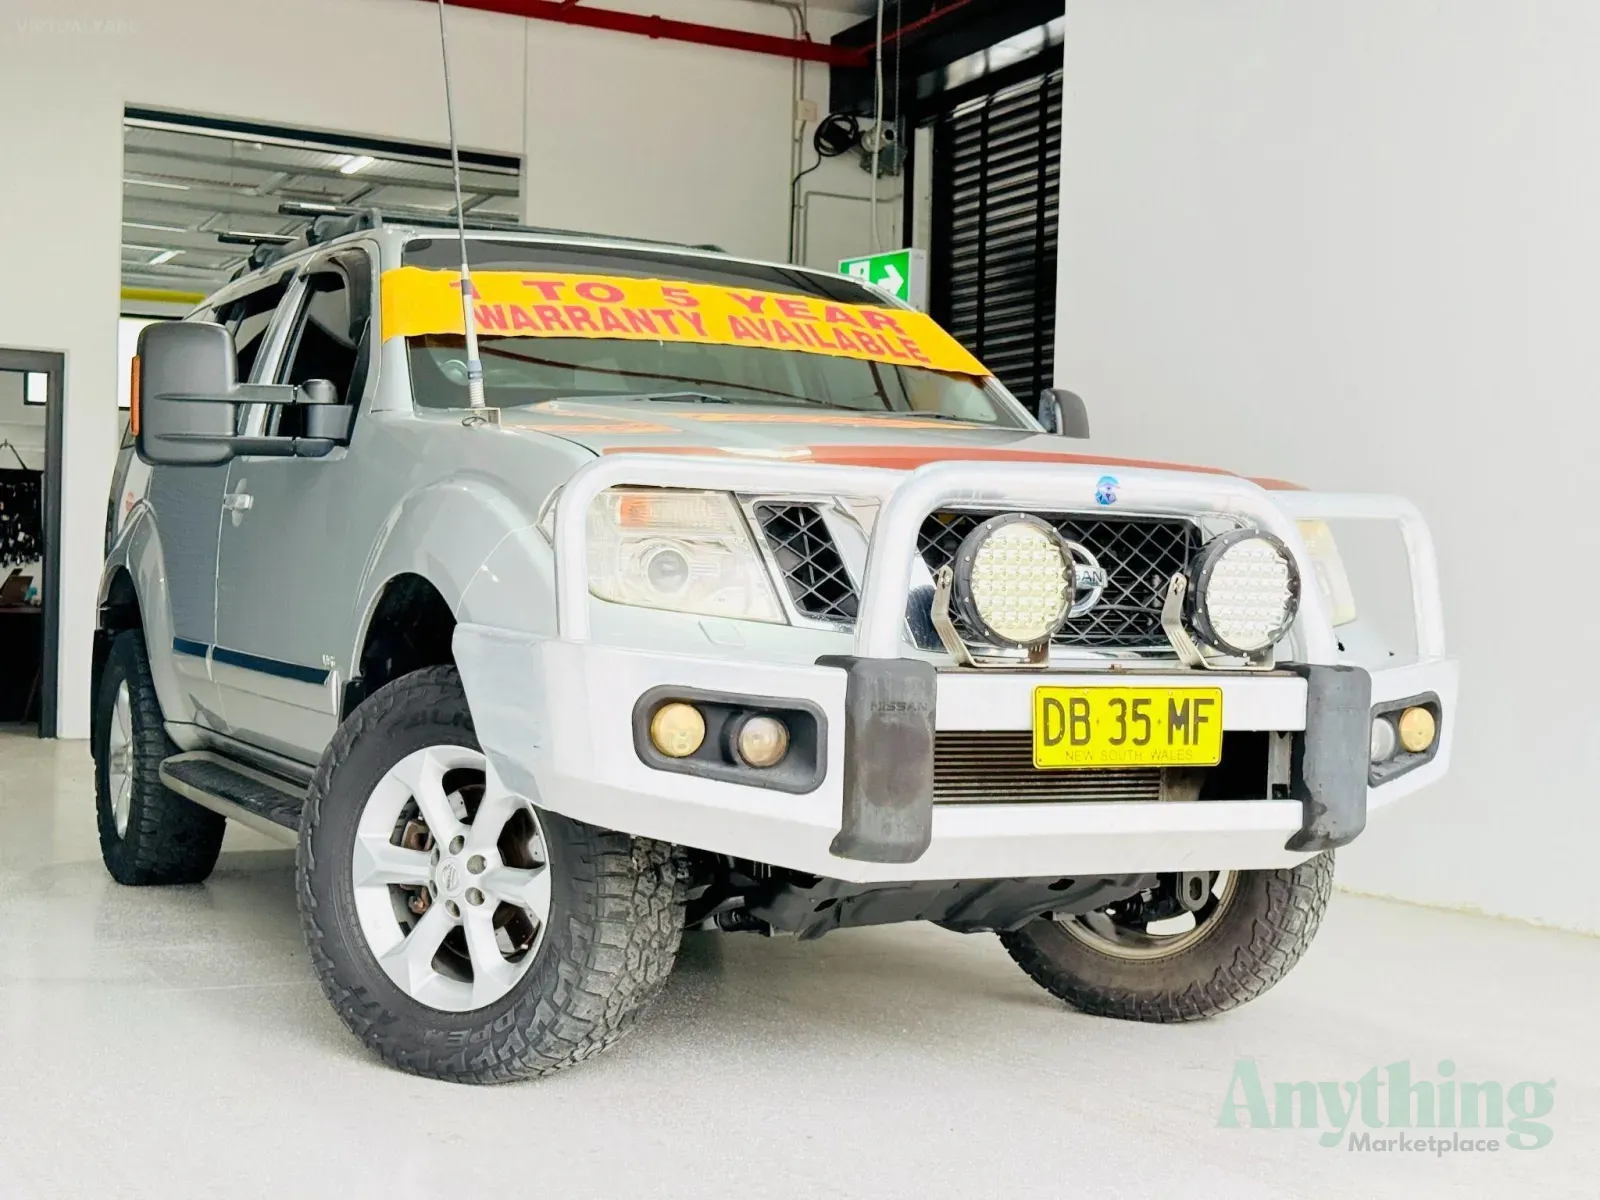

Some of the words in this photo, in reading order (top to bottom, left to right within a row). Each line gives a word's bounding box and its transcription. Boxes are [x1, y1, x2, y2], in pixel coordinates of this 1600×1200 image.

[521, 280, 625, 304] TO
[661, 286, 700, 308] 5
[725, 292, 907, 336] YEAR
[473, 304, 709, 337] WARRANTY
[727, 315, 932, 364] AVAILABLE
[870, 701, 928, 712] NISSAN
[1043, 697, 1091, 746] DB
[1108, 697, 1152, 746] 35
[1167, 697, 1215, 746] MF
[1065, 750, 1093, 761] NEW
[1100, 750, 1143, 761] SOUTH
[1151, 749, 1193, 761] WALES
